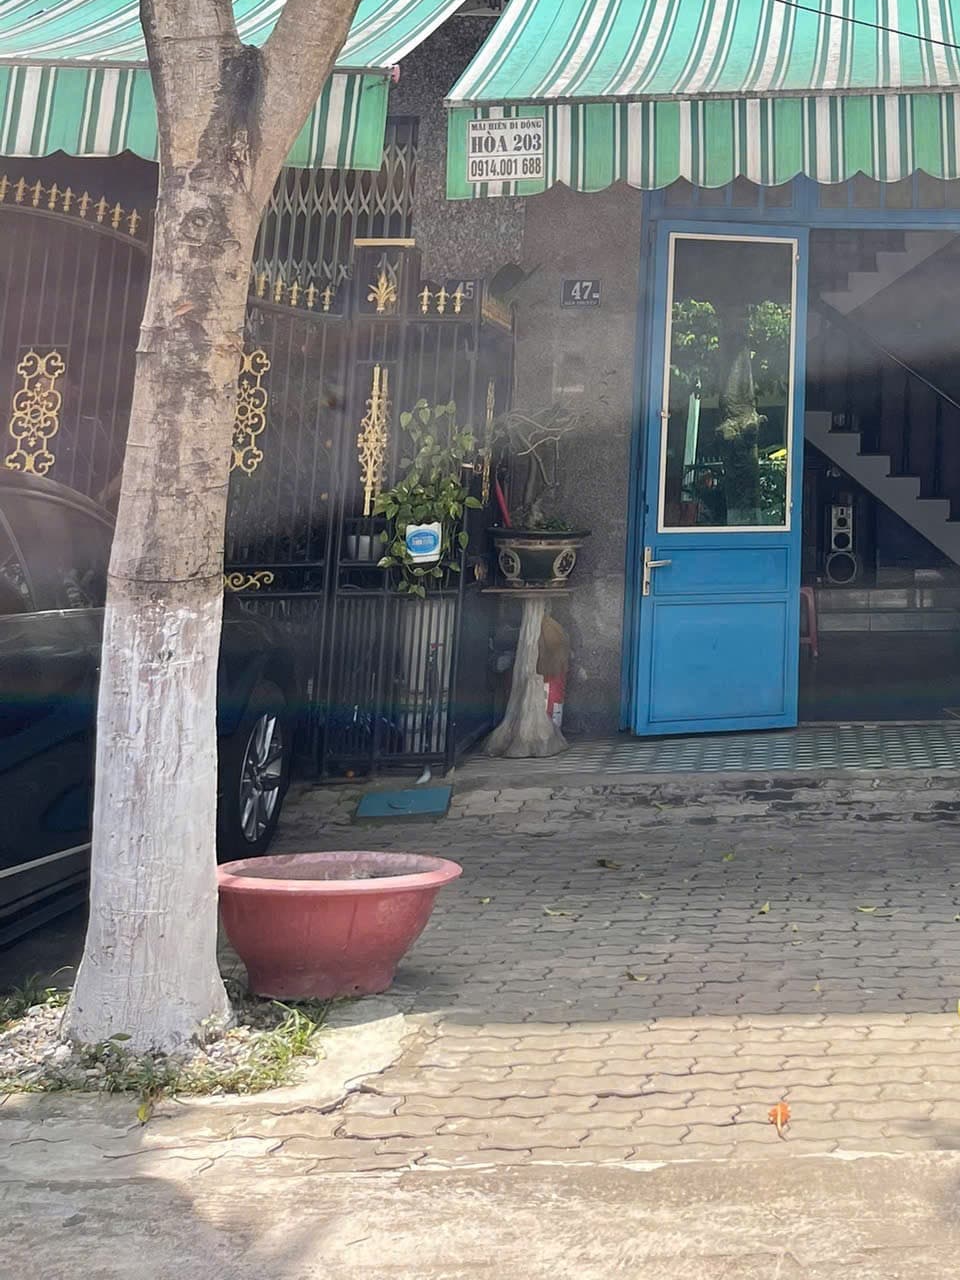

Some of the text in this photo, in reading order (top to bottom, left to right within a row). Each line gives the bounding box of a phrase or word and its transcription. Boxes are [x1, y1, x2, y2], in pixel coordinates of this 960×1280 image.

[471, 131, 542, 153] HÒA 203
[471, 157, 541, 177] 0914.001 688
[571, 281, 593, 300] 47
